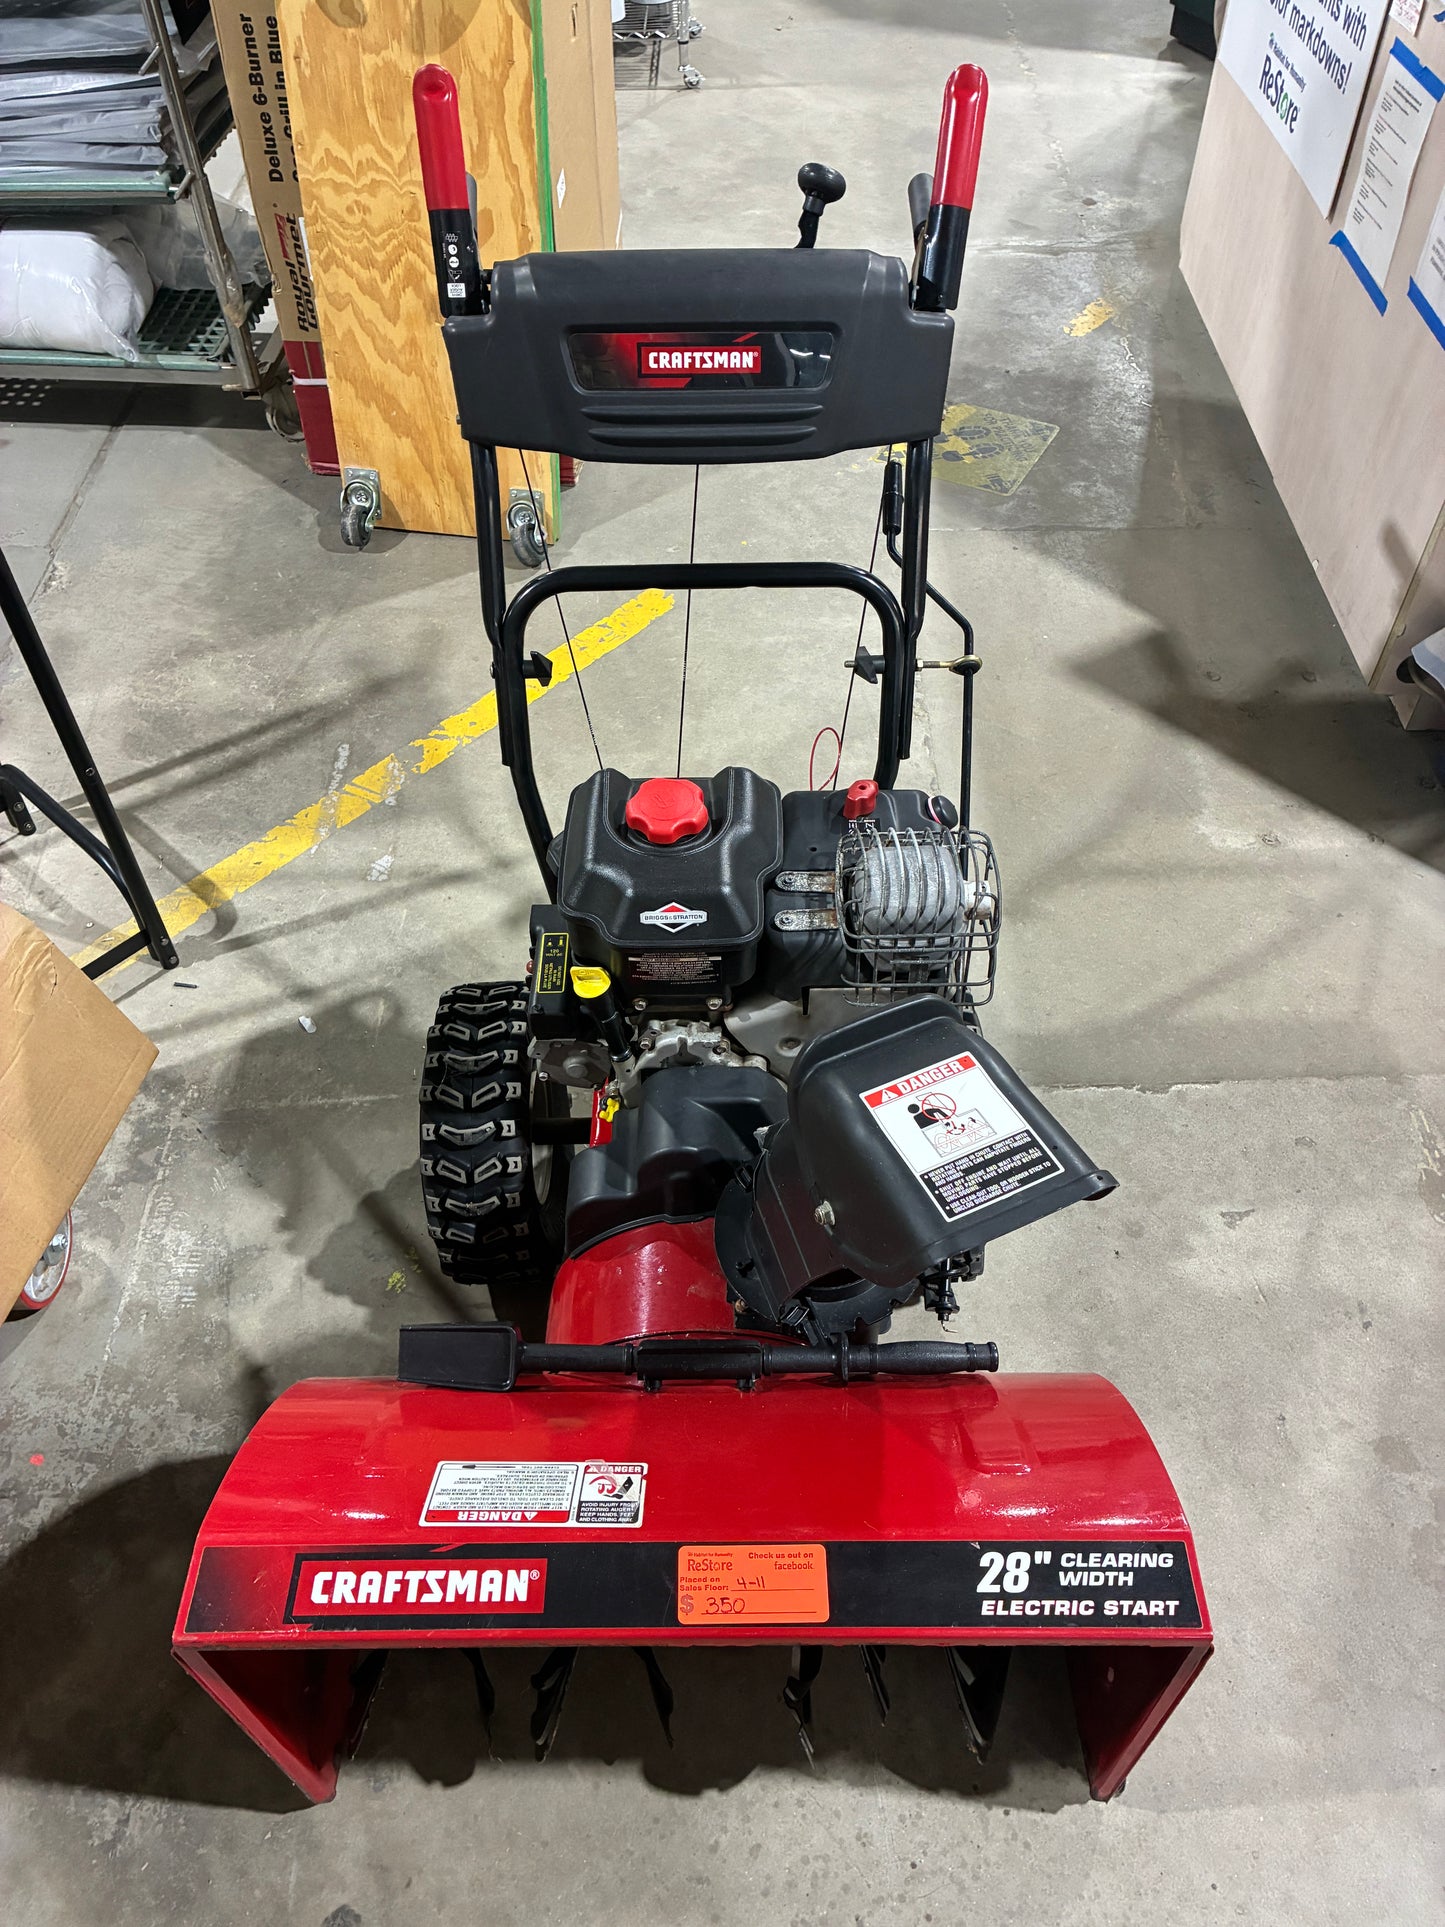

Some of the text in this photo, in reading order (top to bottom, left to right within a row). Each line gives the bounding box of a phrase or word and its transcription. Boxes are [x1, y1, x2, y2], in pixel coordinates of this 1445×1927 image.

[266, 16, 282, 64] Blue
[1342, 4, 1367, 51] with
[1288, 4, 1352, 94] markdowns!
[240, 14, 284, 182] Deluxe 6-Burner
[1259, 54, 1300, 133] ReStore
[286, 212, 318, 330] Gourmet
[284, 260, 309, 332] Royal
[898, 1060, 965, 1094] DANGER
[458, 1511, 522, 1520] DANGER
[688, 1559, 733, 1571] ReStore
[774, 1561, 813, 1570] facebook
[976, 1550, 1052, 1593] 28"
[1060, 1552, 1174, 1568] CLEARING
[736, 1576, 766, 1589] 4-11
[1058, 1571, 1134, 1586] WIDTH
[680, 1594, 694, 1615] $
[706, 1597, 745, 1615] 350
[981, 1600, 1180, 1616] ELECTRIC START
